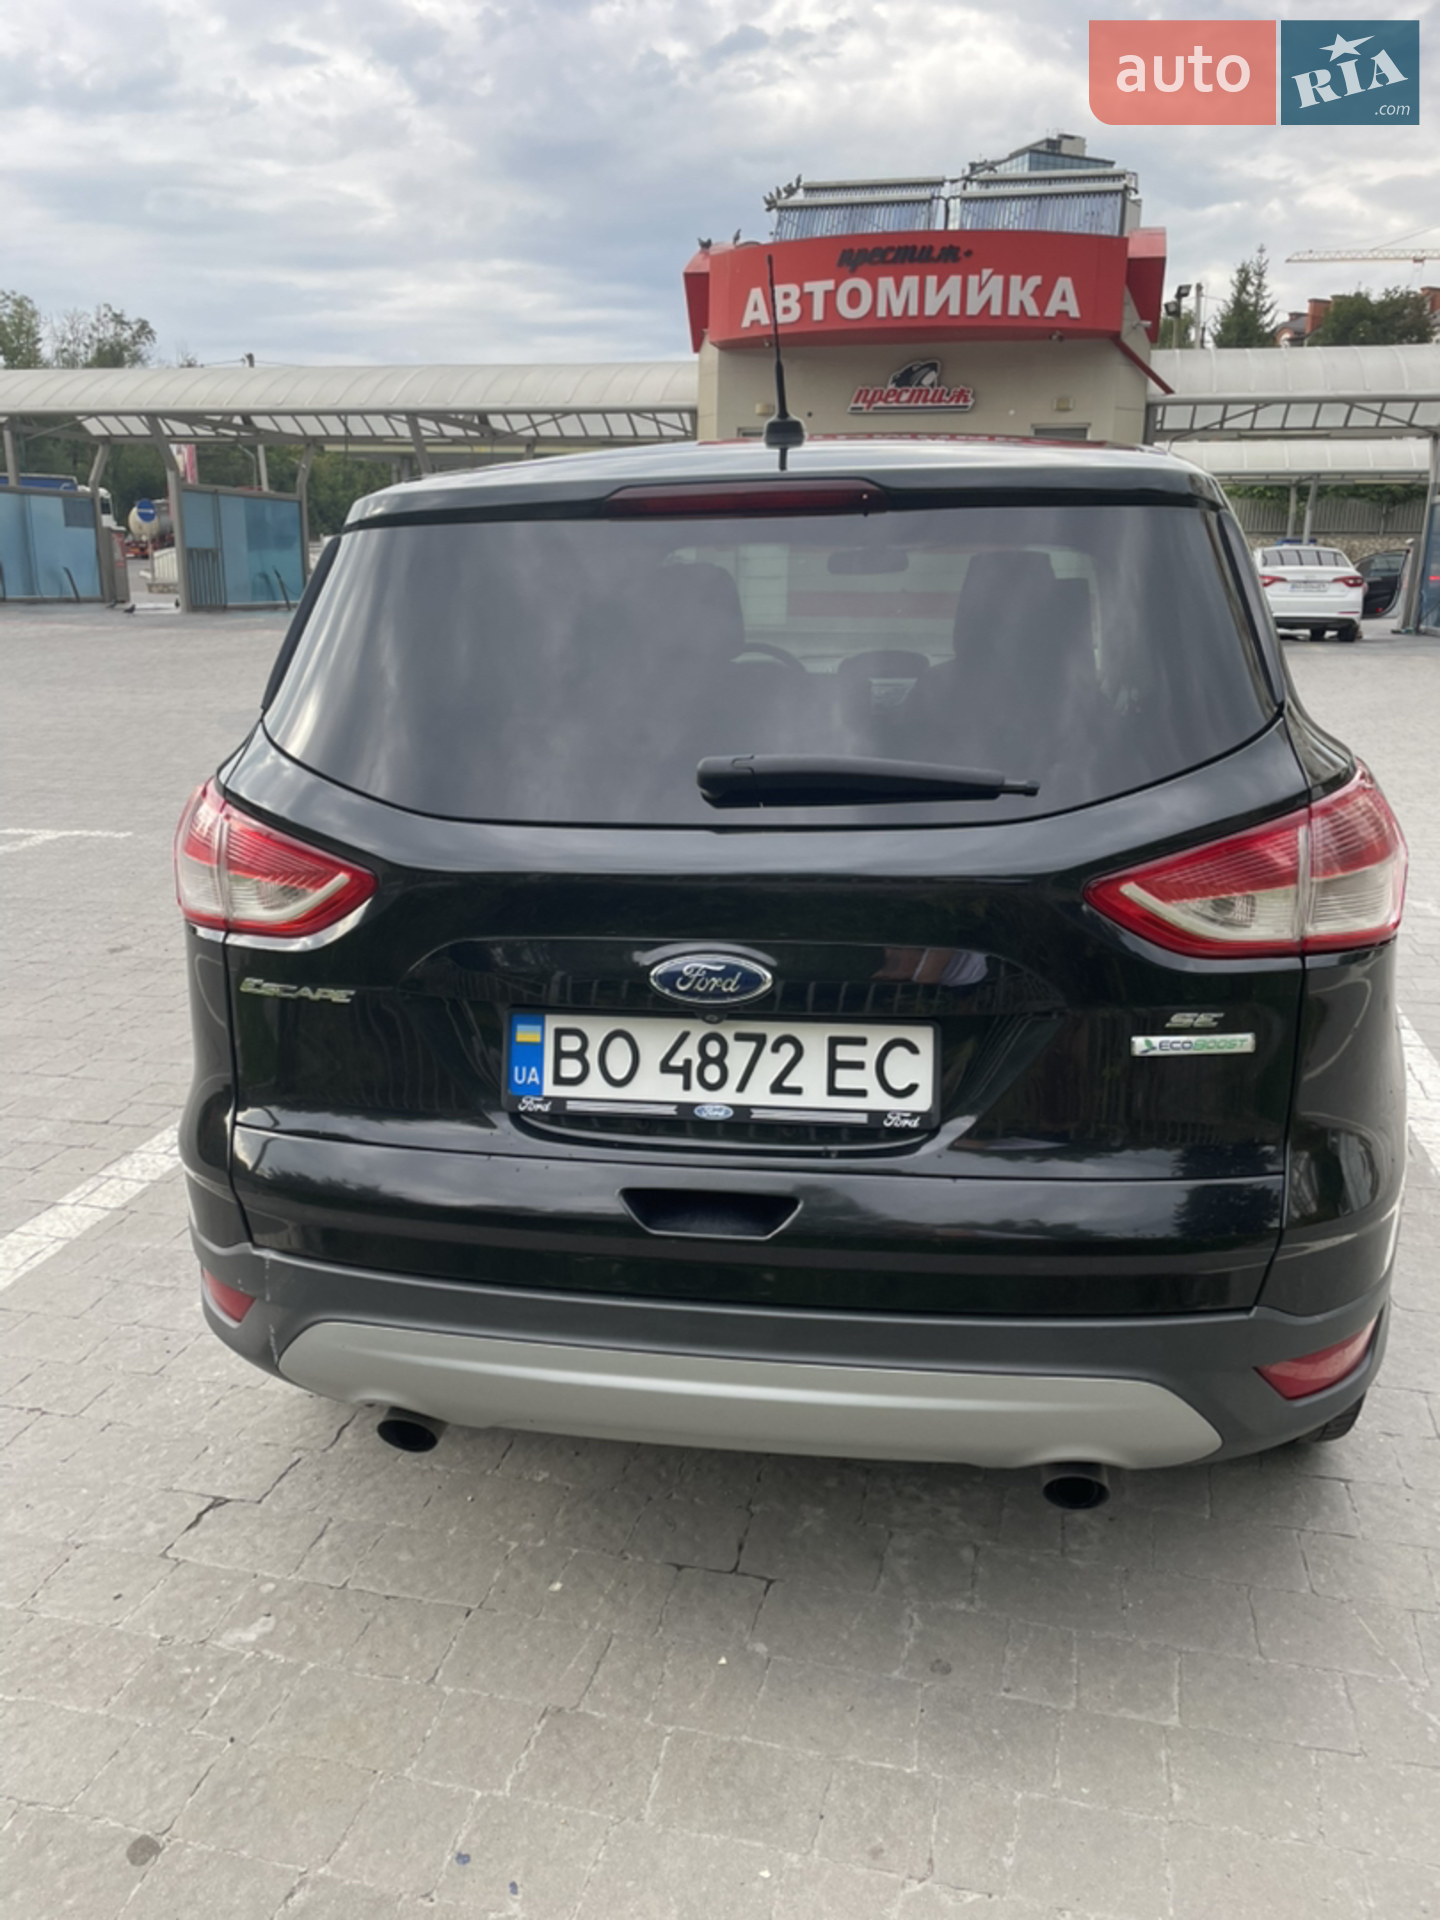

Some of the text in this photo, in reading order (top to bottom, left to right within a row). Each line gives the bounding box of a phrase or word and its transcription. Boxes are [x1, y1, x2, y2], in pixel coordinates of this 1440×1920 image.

[740, 268, 1082, 329] АВТОМИЙКА
[675, 962, 742, 994] Ford
[239, 977, 356, 1003] ESCAPE
[1164, 1012, 1226, 1028] SE
[1157, 1037, 1249, 1051] ECOBOOST
[552, 1027, 921, 1100] BO 4872 EC
[513, 1065, 541, 1086] UA
[517, 1094, 552, 1113] Ford
[882, 1111, 920, 1129] Ford
